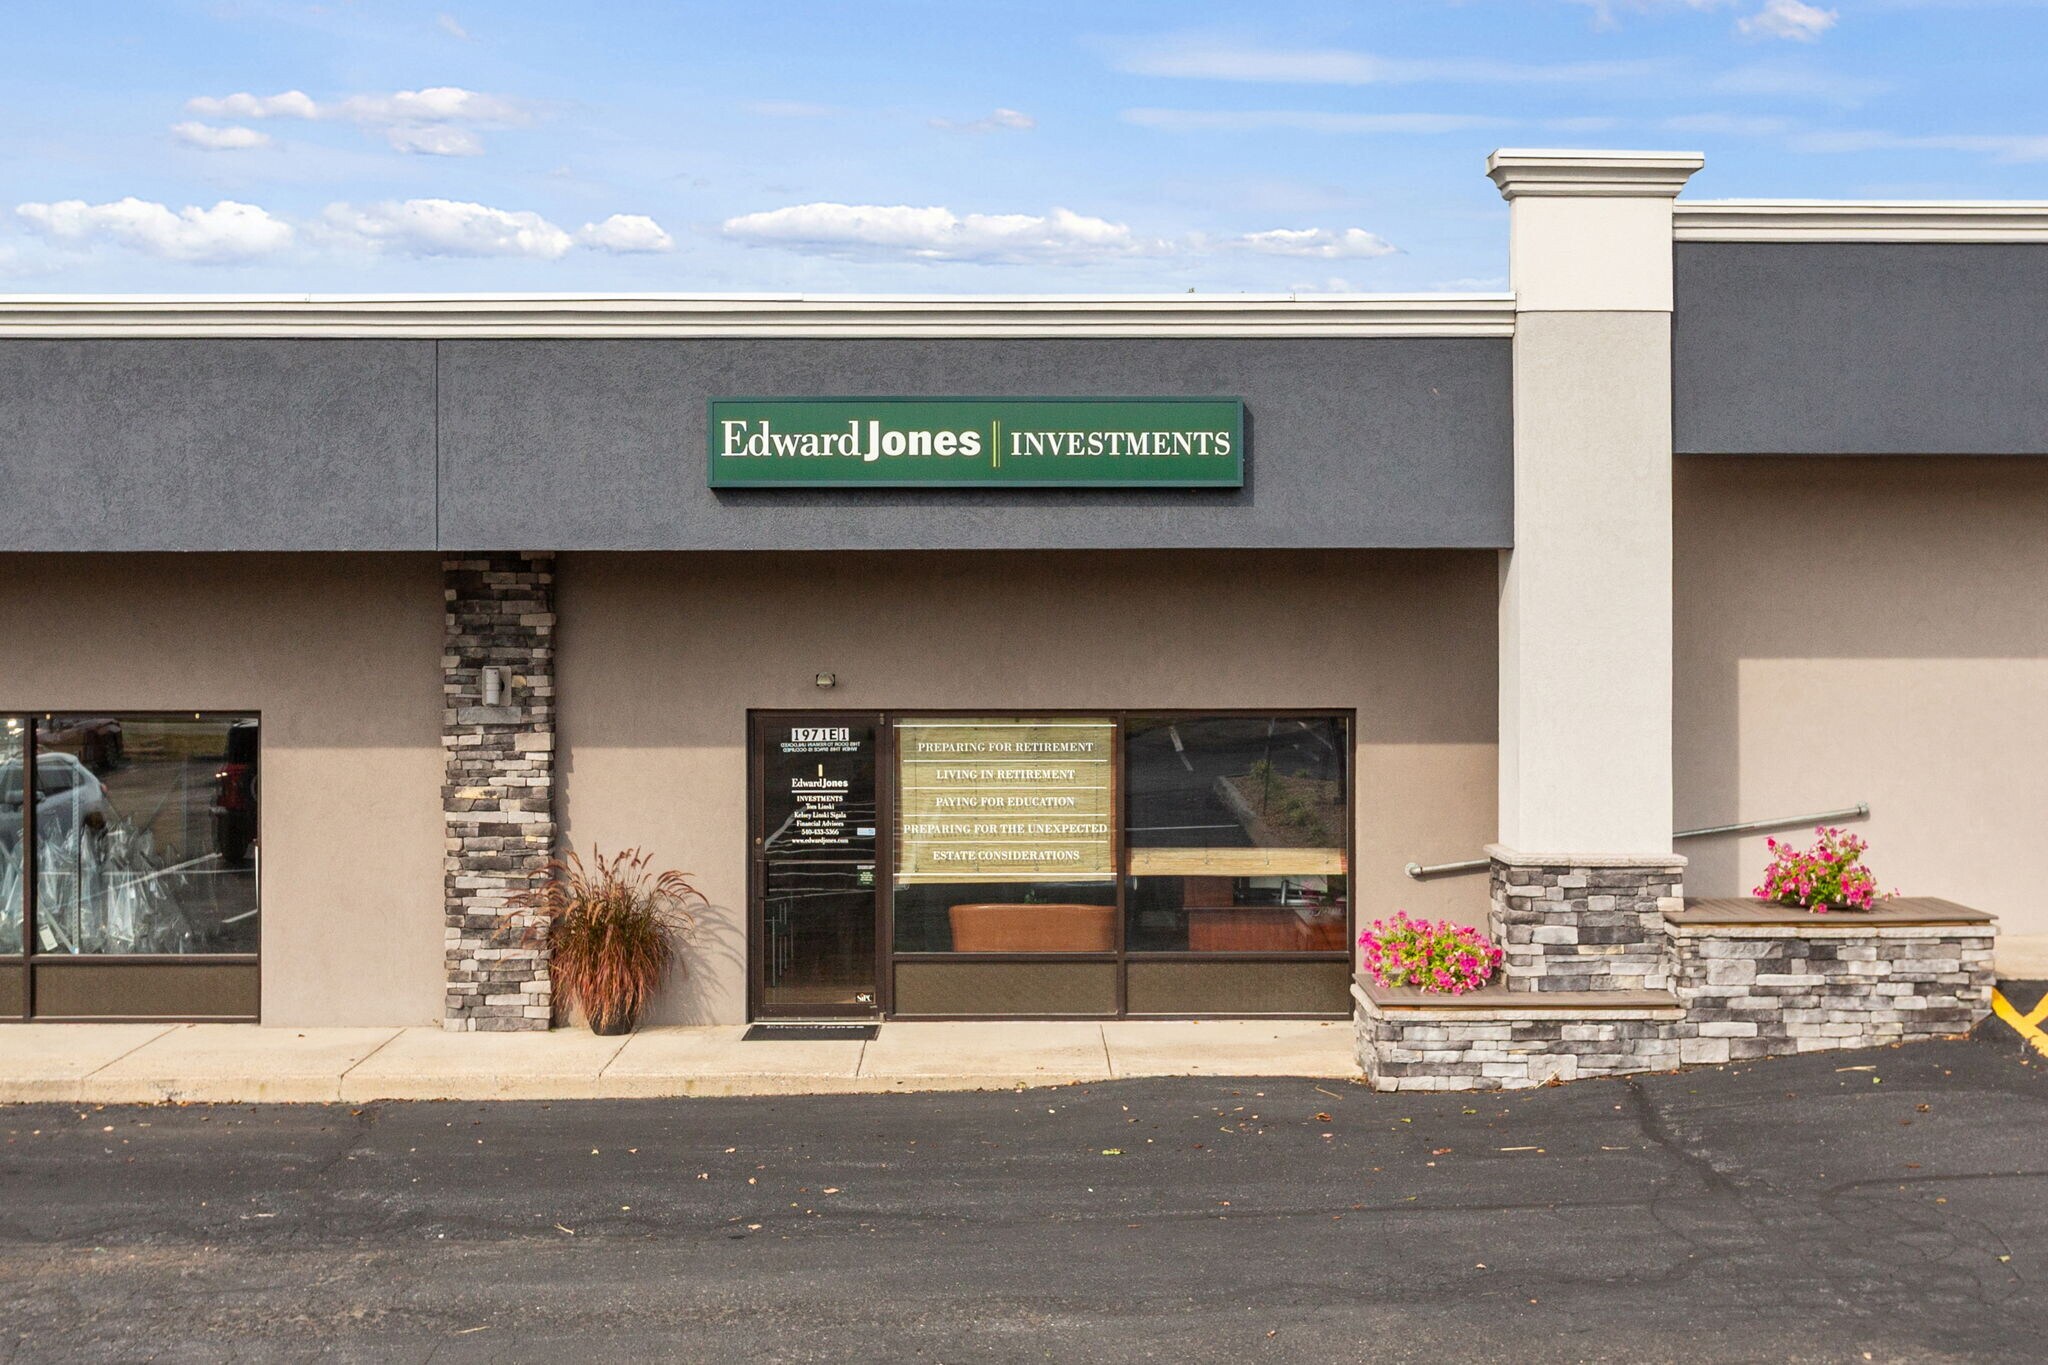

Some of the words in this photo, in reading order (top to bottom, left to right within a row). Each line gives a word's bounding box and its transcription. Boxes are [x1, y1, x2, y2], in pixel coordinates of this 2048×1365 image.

[1010, 431, 1231, 456] INVESTMENTS
[918, 742, 985, 752] PREPARING
[988, 742, 1013, 752] FOR
[1015, 742, 1094, 752] RETIREMENT
[936, 770, 977, 780] LIVING
[980, 770, 994, 779] IN
[997, 770, 1076, 780] RETIREMENT
[935, 797, 977, 807] PAYING
[980, 797, 1005, 807] FOR
[1007, 797, 1075, 807] EDUCATION
[903, 824, 971, 834] PREPARING
[974, 824, 997, 834] FOR
[999, 824, 1025, 834] THE
[1028, 824, 1108, 834] UNEXPECTED
[791, 836, 849, 845] www.edwardjones.com
[933, 851, 977, 861] ESTATE
[978, 851, 1080, 861] CONSIDERATIONS
